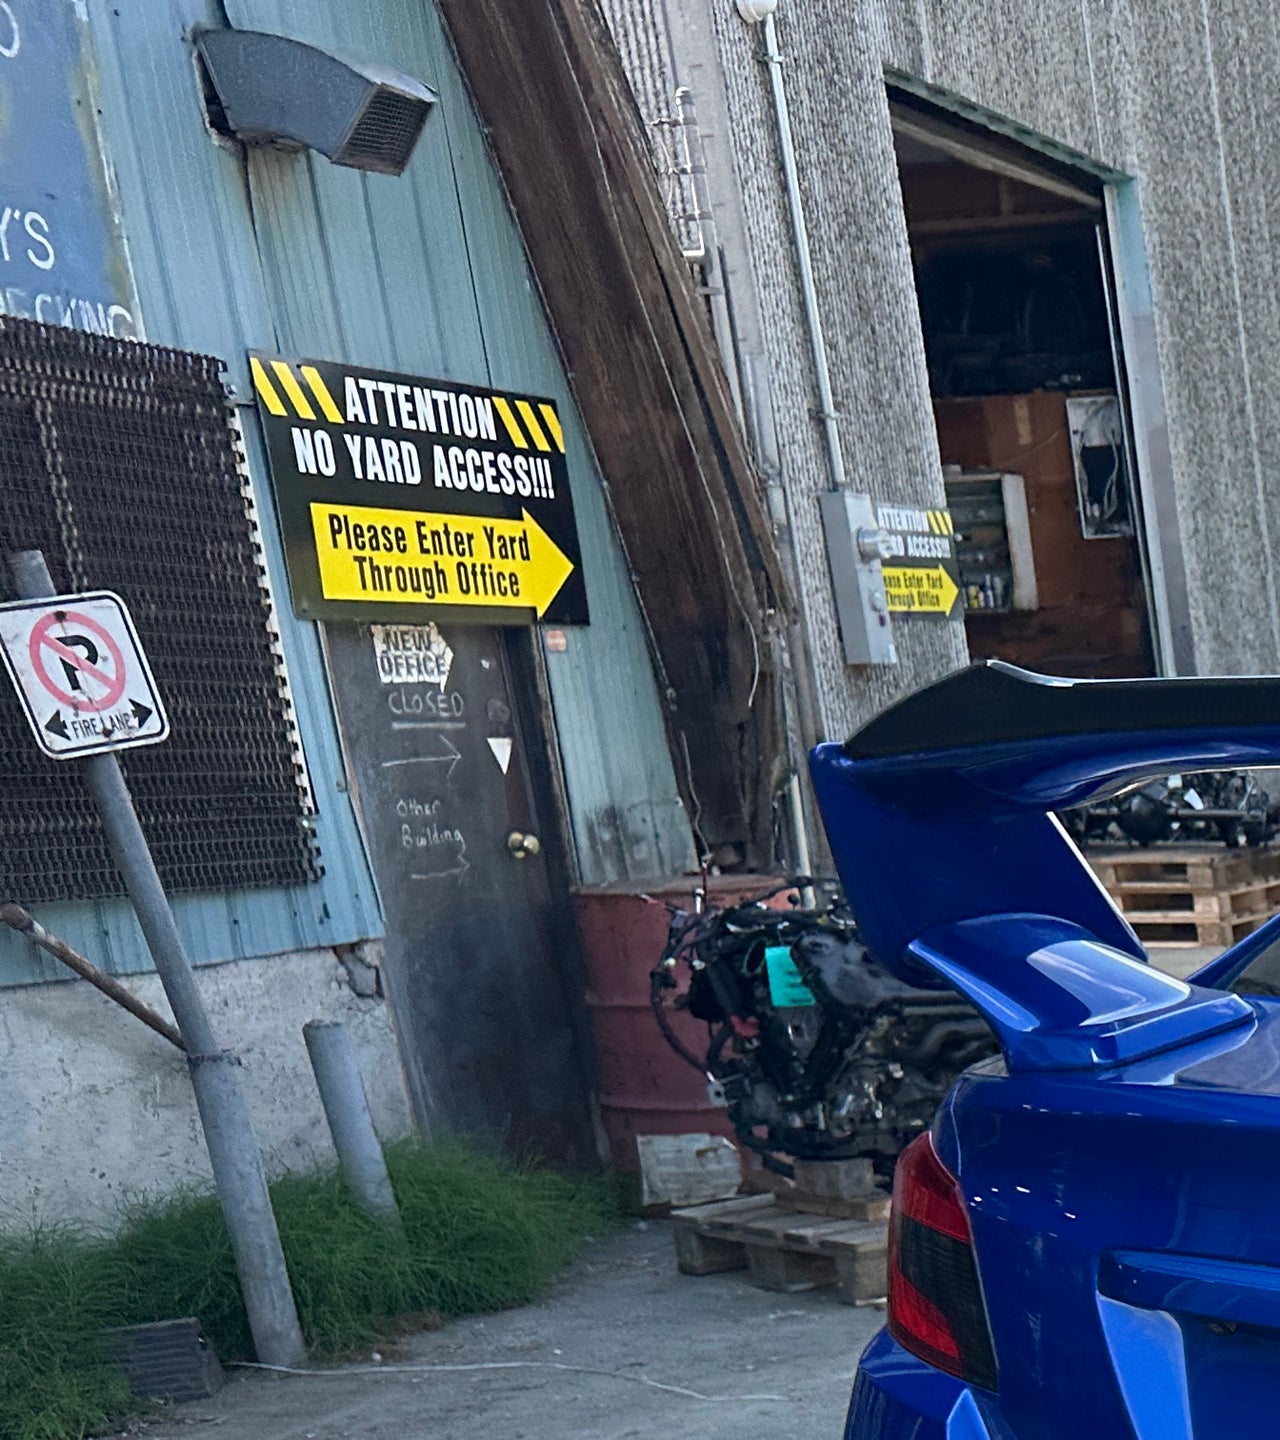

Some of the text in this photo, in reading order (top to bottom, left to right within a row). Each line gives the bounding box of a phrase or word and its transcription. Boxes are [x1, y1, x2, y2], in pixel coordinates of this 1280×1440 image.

[344, 376, 497, 441] ATTENTION
[291, 427, 555, 499] NO YARD ACCESS!!!
[878, 507, 930, 532] ATTENTION
[328, 513, 531, 562] Please Enter Yard
[353, 555, 520, 600] Through Office
[382, 629, 431, 652] NEW
[380, 653, 447, 679] OFFICE
[388, 688, 464, 717] CLOSED
[71, 717, 101, 739] FIRE
